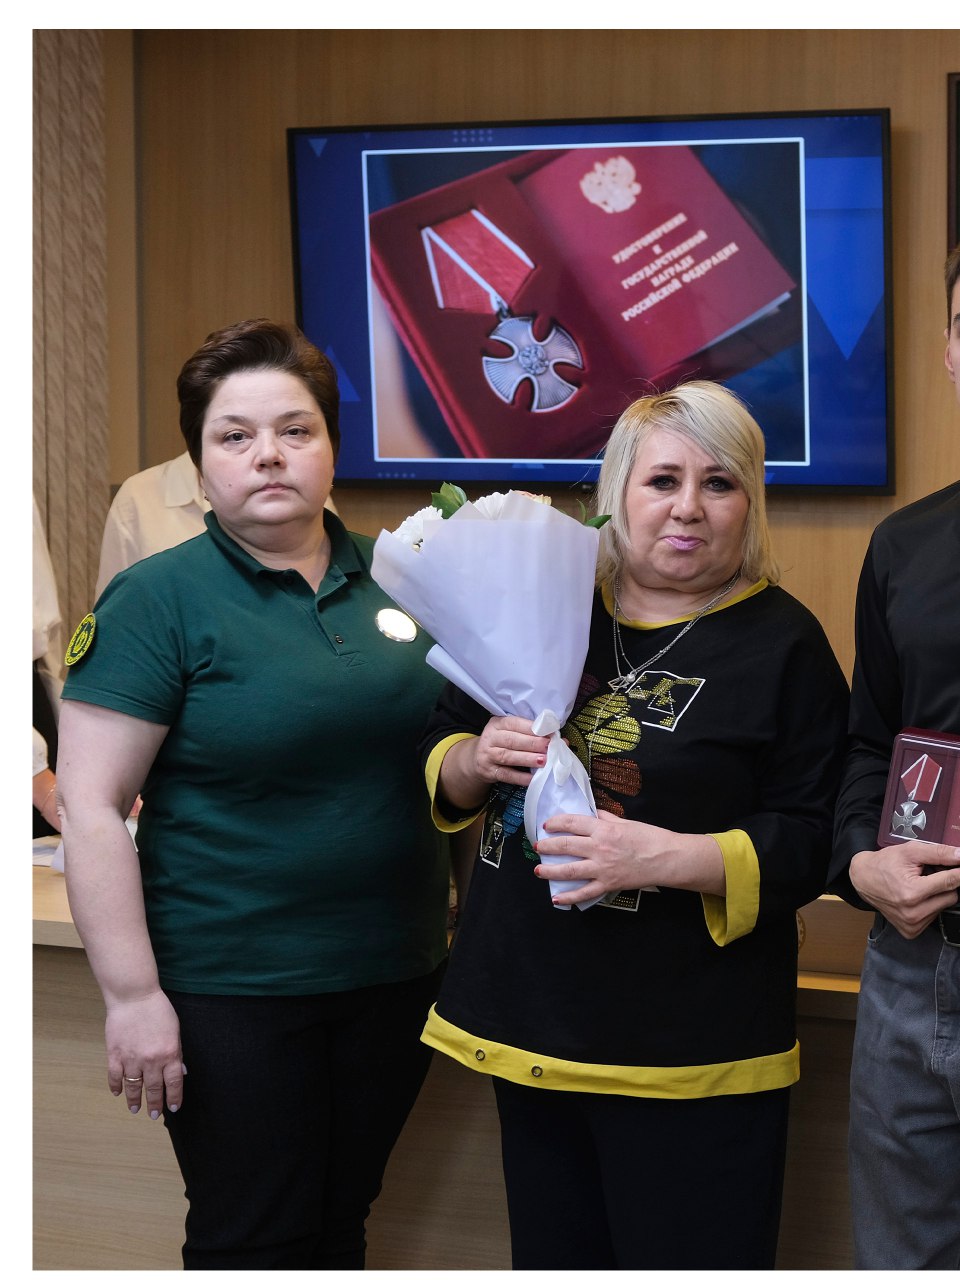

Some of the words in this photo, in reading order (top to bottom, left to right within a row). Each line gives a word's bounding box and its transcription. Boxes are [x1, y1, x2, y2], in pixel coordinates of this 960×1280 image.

[621, 230, 708, 289] ГОСУДАРСТВЕННОЙ
[621, 278, 682, 321] РОССИЙСКОЙ
[682, 242, 739, 283] ФЕДЕРАЦИИ
[650, 255, 695, 287] НАГРАДЕ
